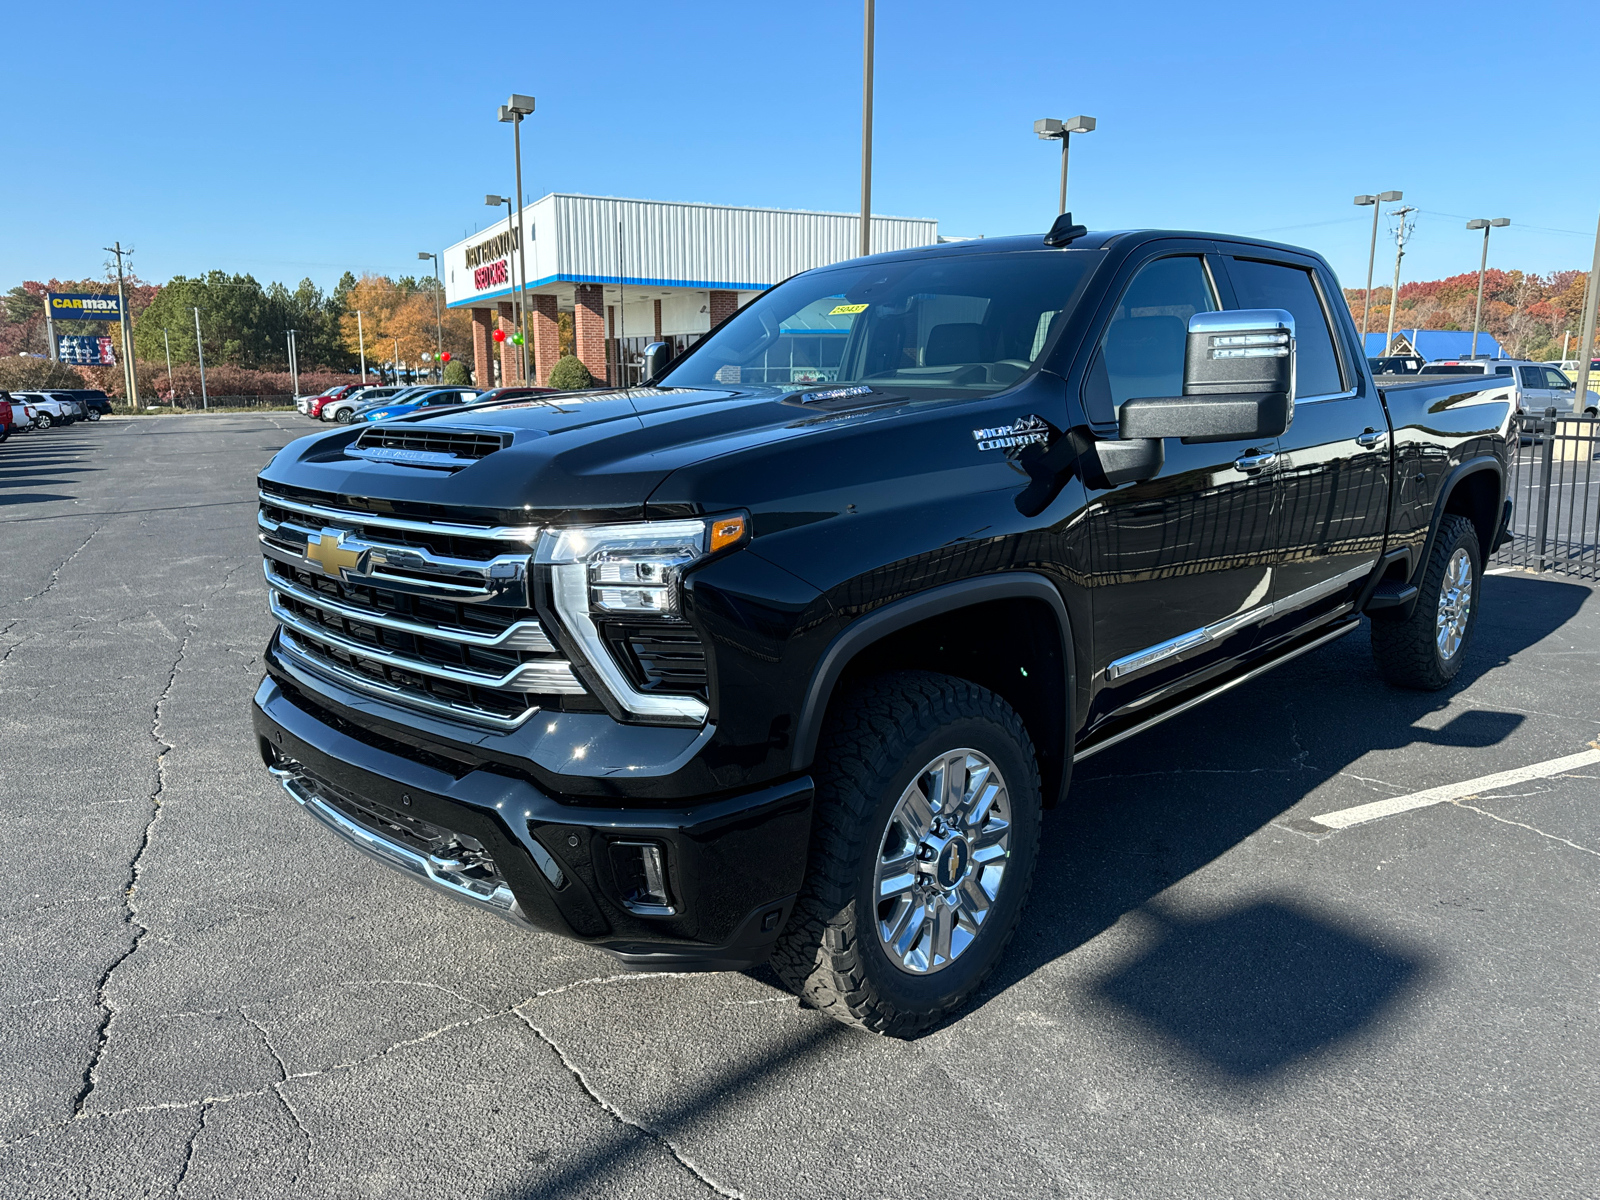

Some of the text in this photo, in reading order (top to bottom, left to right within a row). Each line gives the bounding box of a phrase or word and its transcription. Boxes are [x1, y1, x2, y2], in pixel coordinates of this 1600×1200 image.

[474, 259, 508, 291] USED CARS
[977, 432, 1049, 450] COUNTRY
